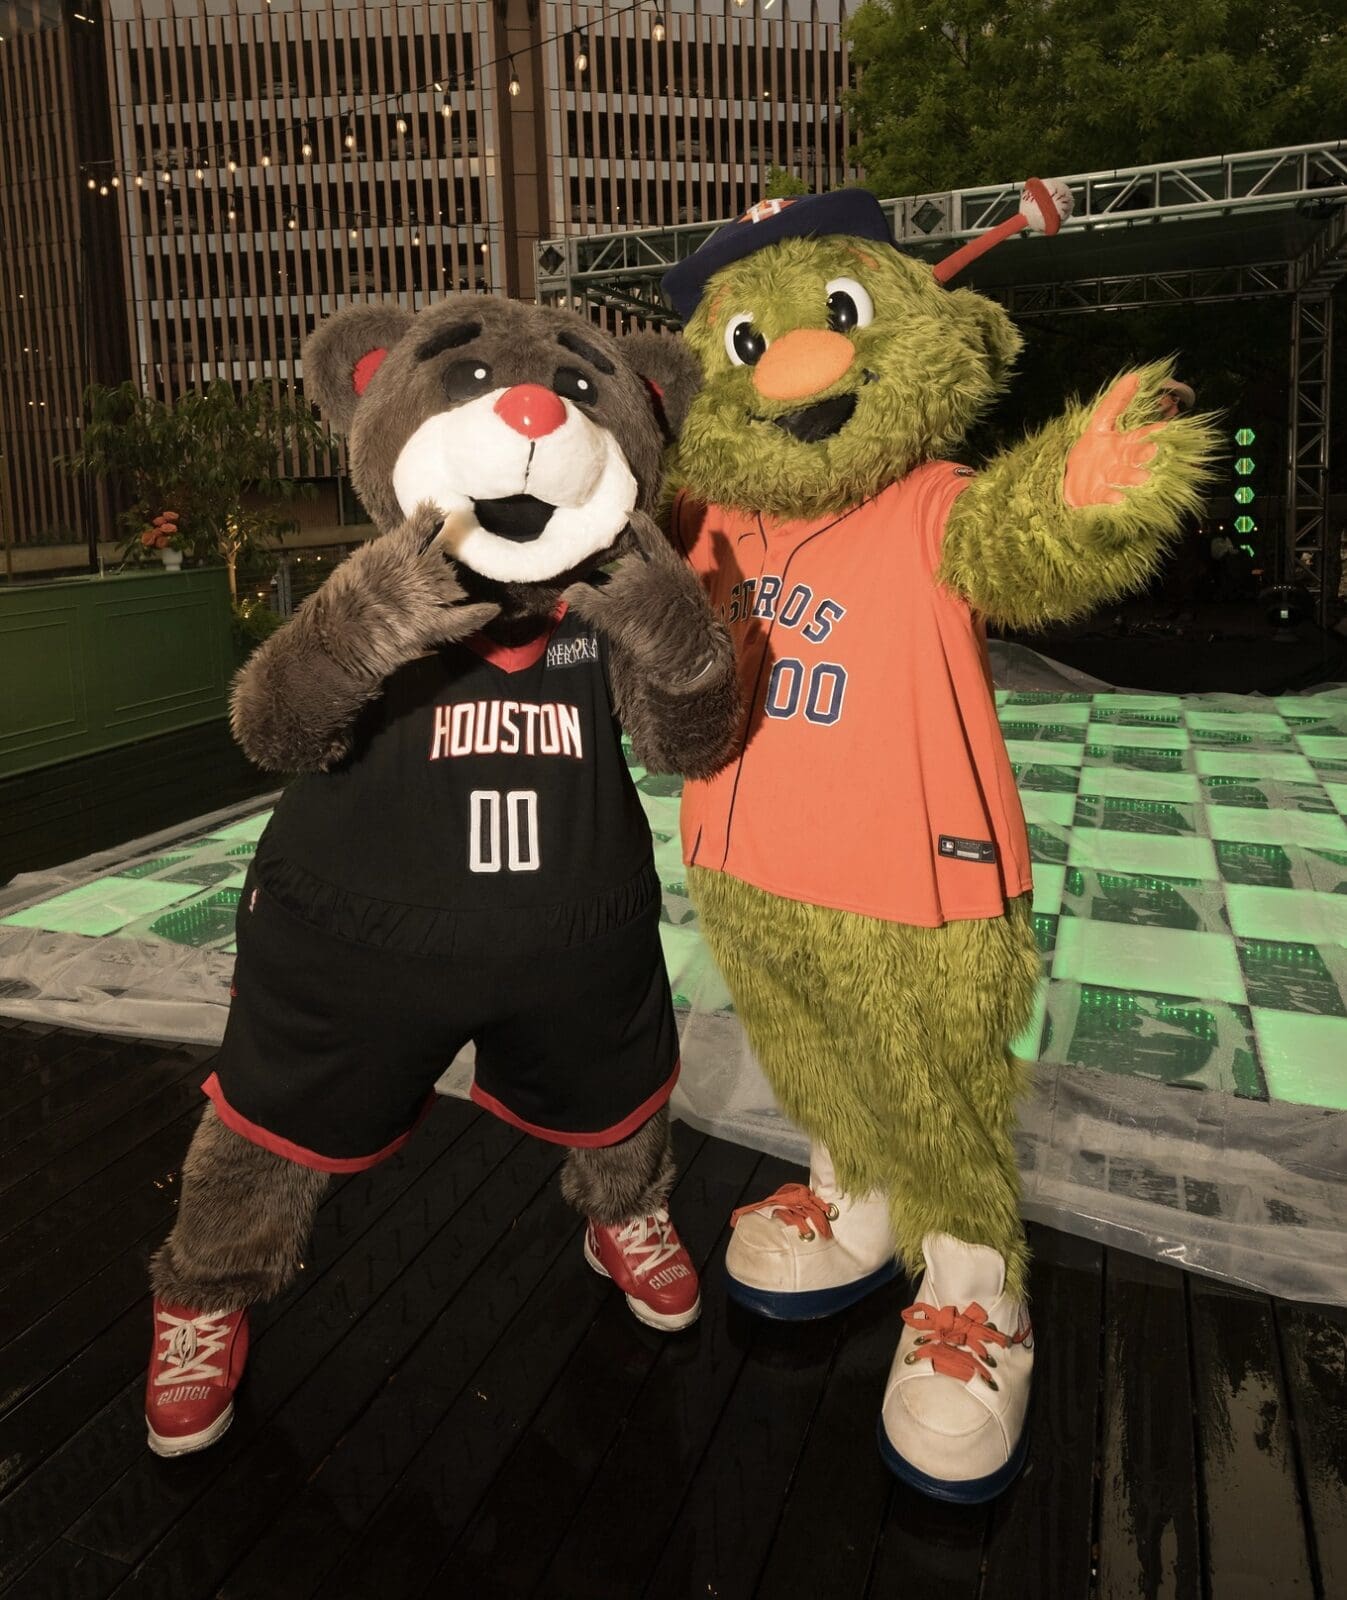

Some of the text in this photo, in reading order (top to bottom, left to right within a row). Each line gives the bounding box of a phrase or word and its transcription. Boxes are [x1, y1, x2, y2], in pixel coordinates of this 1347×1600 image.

[721, 574, 847, 644] STROS
[764, 656, 848, 727] 00
[429, 699, 584, 761] HOUSTON
[469, 790, 540, 873] 00
[648, 1264, 690, 1290] CLUTCH
[157, 1386, 211, 1406] CLUTCH
